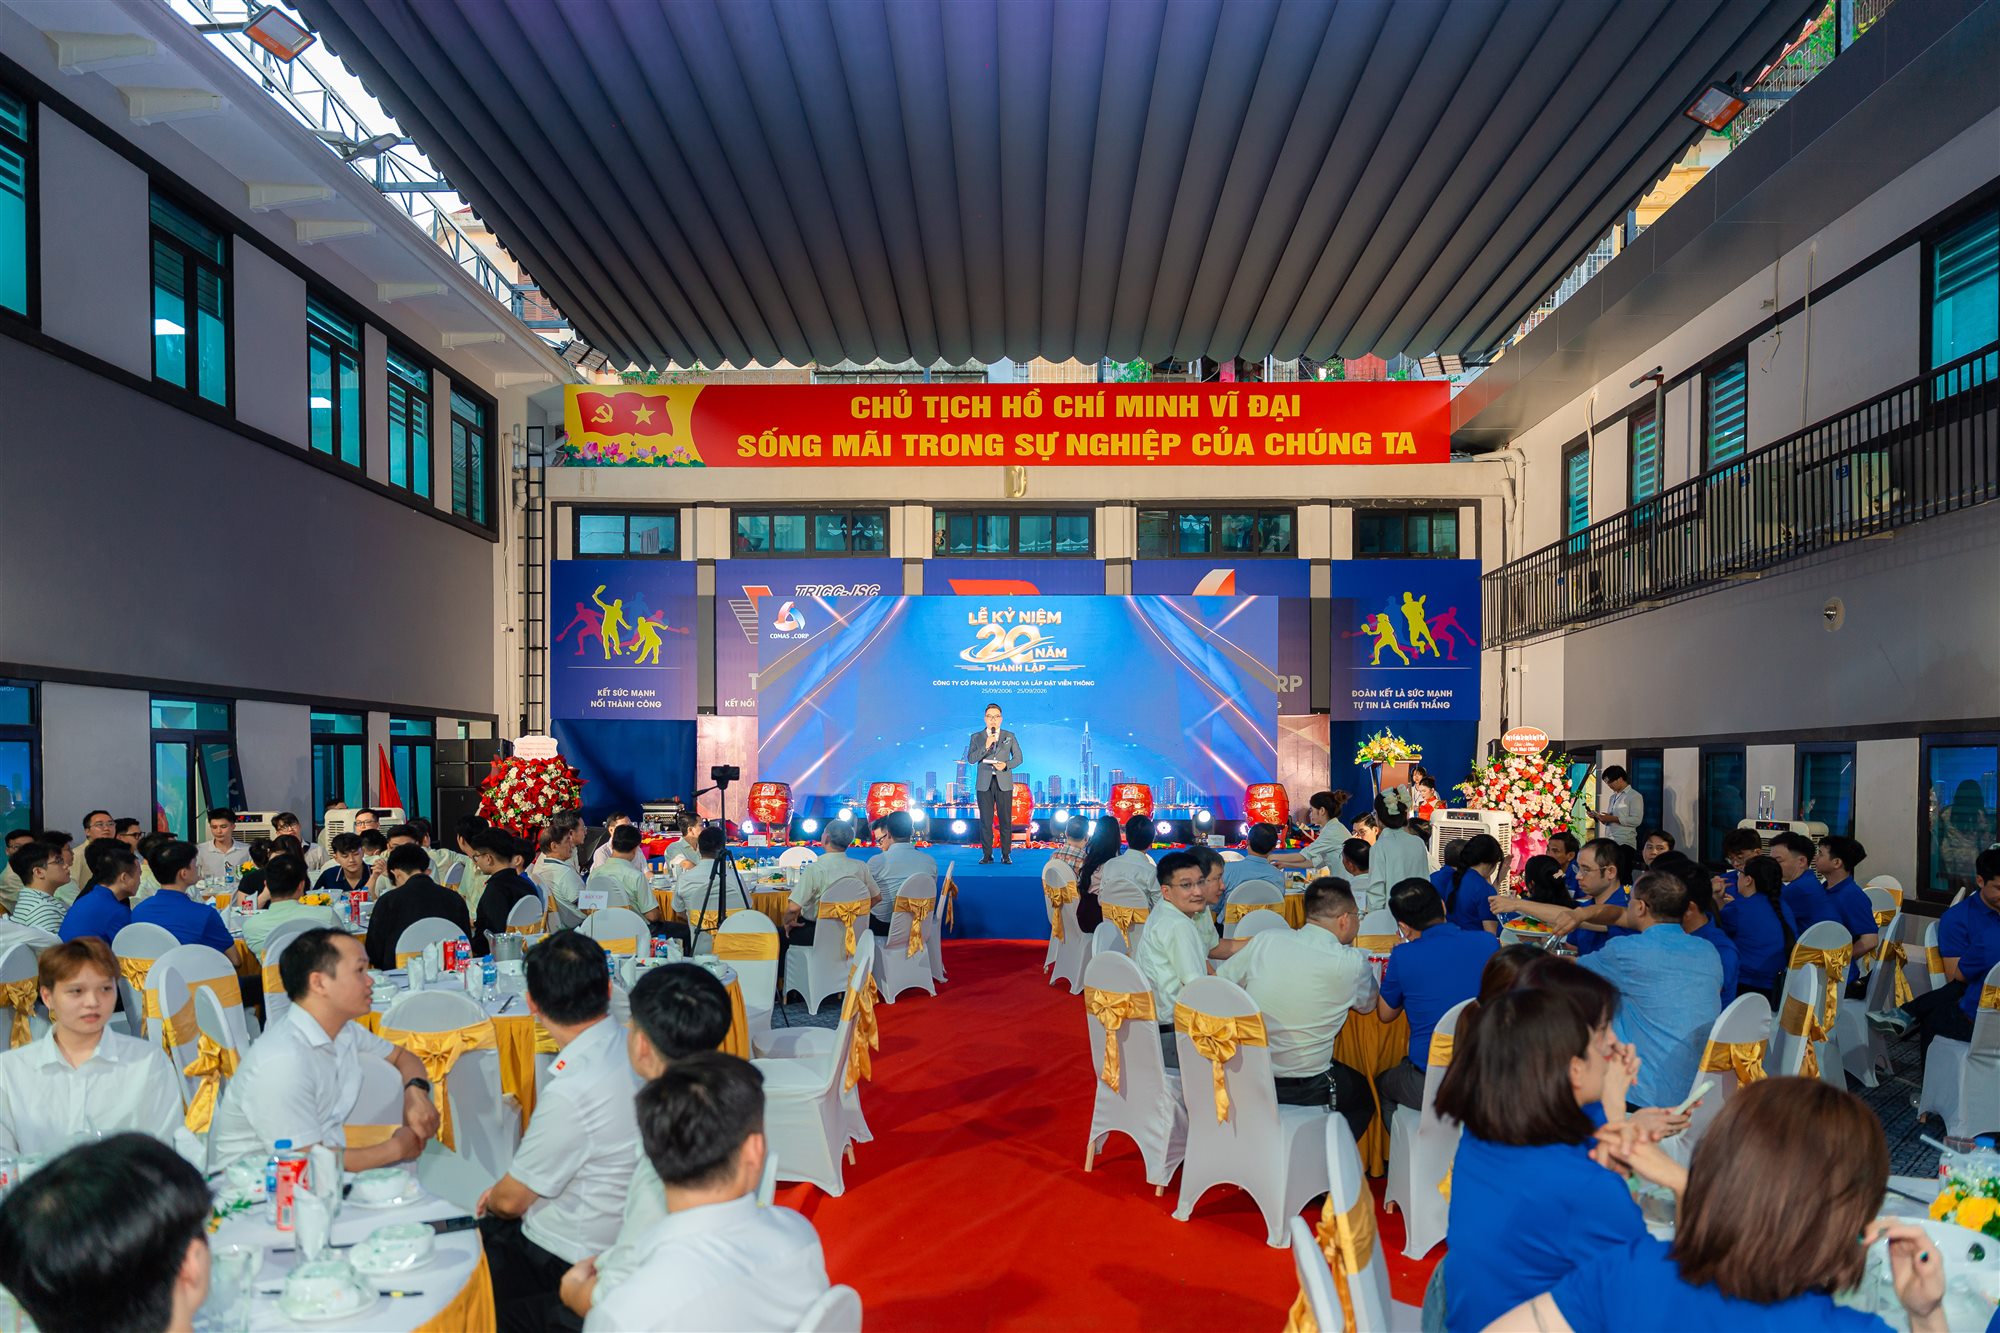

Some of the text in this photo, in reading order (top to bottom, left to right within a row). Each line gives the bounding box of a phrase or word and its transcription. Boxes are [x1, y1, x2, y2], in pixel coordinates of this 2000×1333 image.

[851, 388, 1300, 423] CHỦ TỊCH HỒ CHÍ MINH VĨ ĐẠI
[737, 425, 1417, 461] SỐNG MÃI TRONG SỰ NGHIỆP CỦA CHÚNG TA
[968, 606, 1062, 627] LỄ KỶ NIỆM
[976, 623, 1042, 664] 20
[1035, 645, 1068, 659] NĂM
[986, 662, 1046, 674] THÀNH LẬP
[1277, 675, 1303, 693] RP
[597, 686, 656, 698] KẾT SỨC MẠNH
[1351, 687, 1453, 699] ĐOÀN KẾT LÀ SỨC MẠNH
[590, 698, 663, 708] NỐI THÀNH CÔNG
[724, 698, 755, 708] KẾT NỐI
[1353, 699, 1451, 710] TỰ TIN LÀ CHIẾN THẮNG
